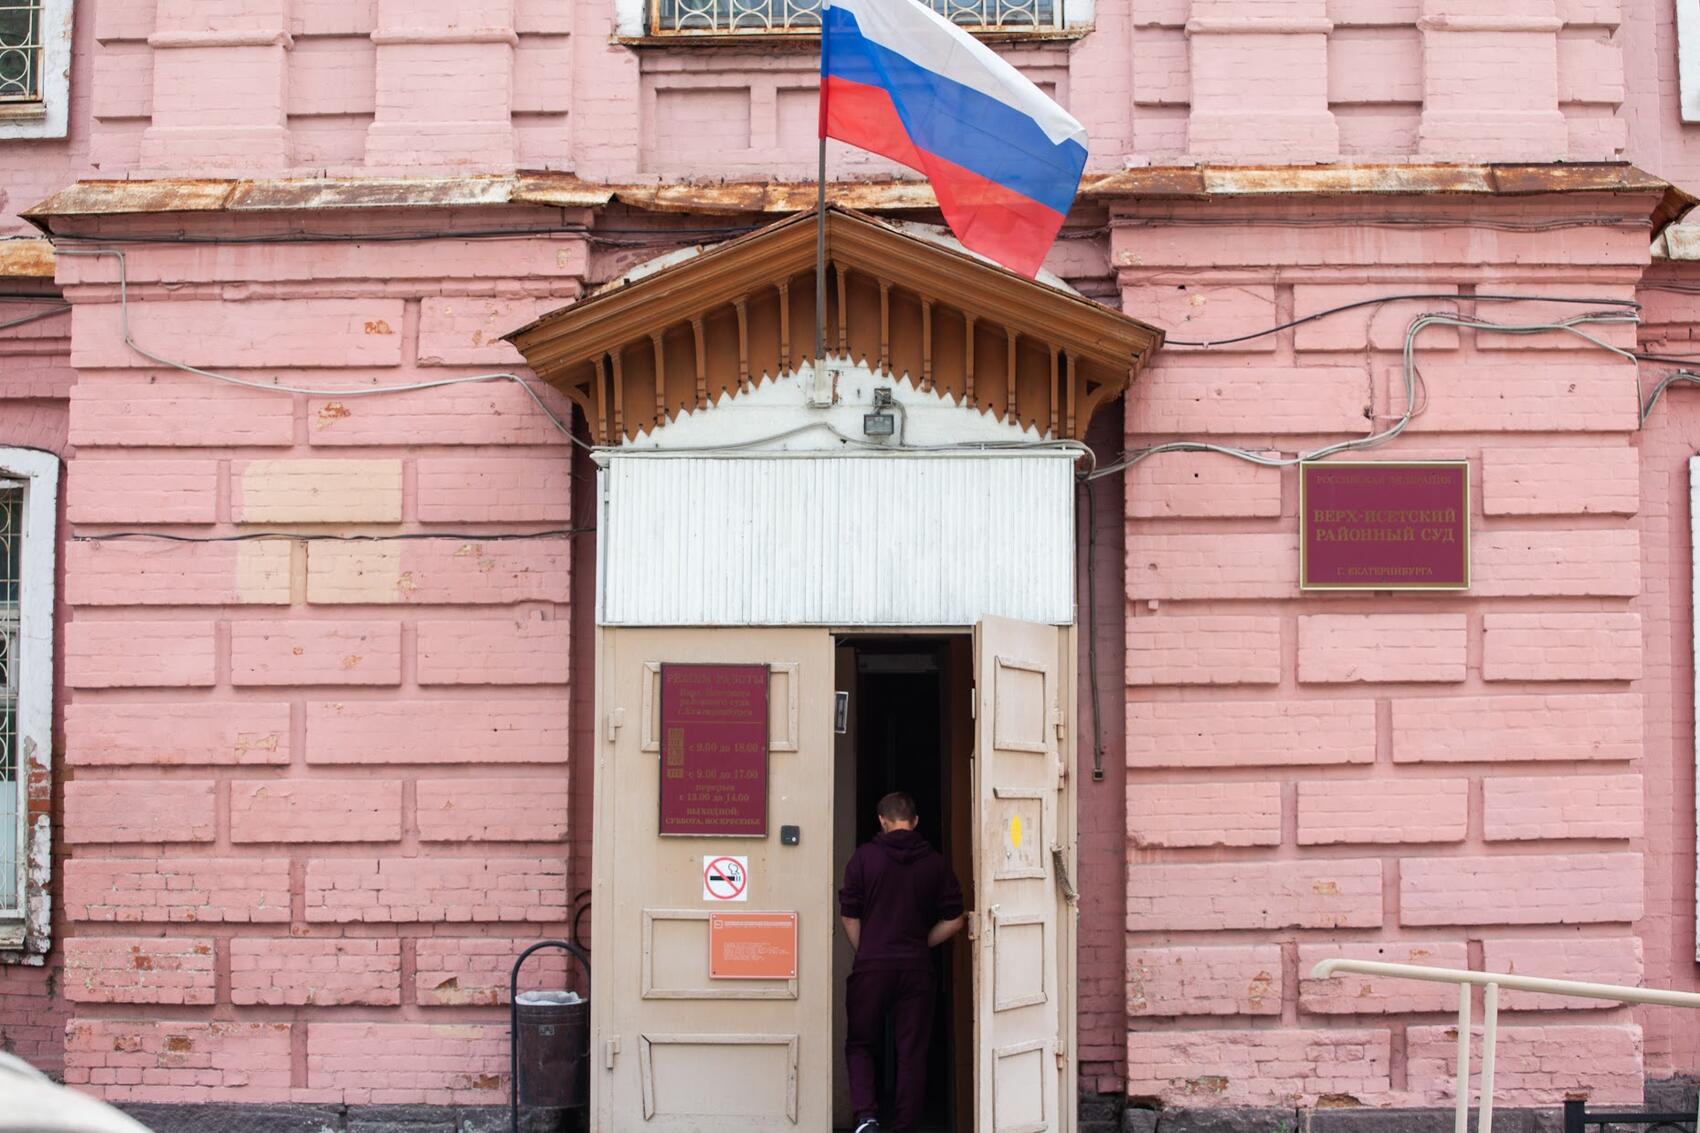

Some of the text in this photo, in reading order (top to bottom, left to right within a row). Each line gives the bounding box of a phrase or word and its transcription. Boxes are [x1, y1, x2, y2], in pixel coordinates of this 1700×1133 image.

[1314, 508, 1456, 523] ВЕРХ-ИСЕТСКИЙ
[1316, 526, 1456, 544] РАЙОННЫЙ СУД
[1348, 566, 1433, 577] ЕКАТЕРИНБУРГА
